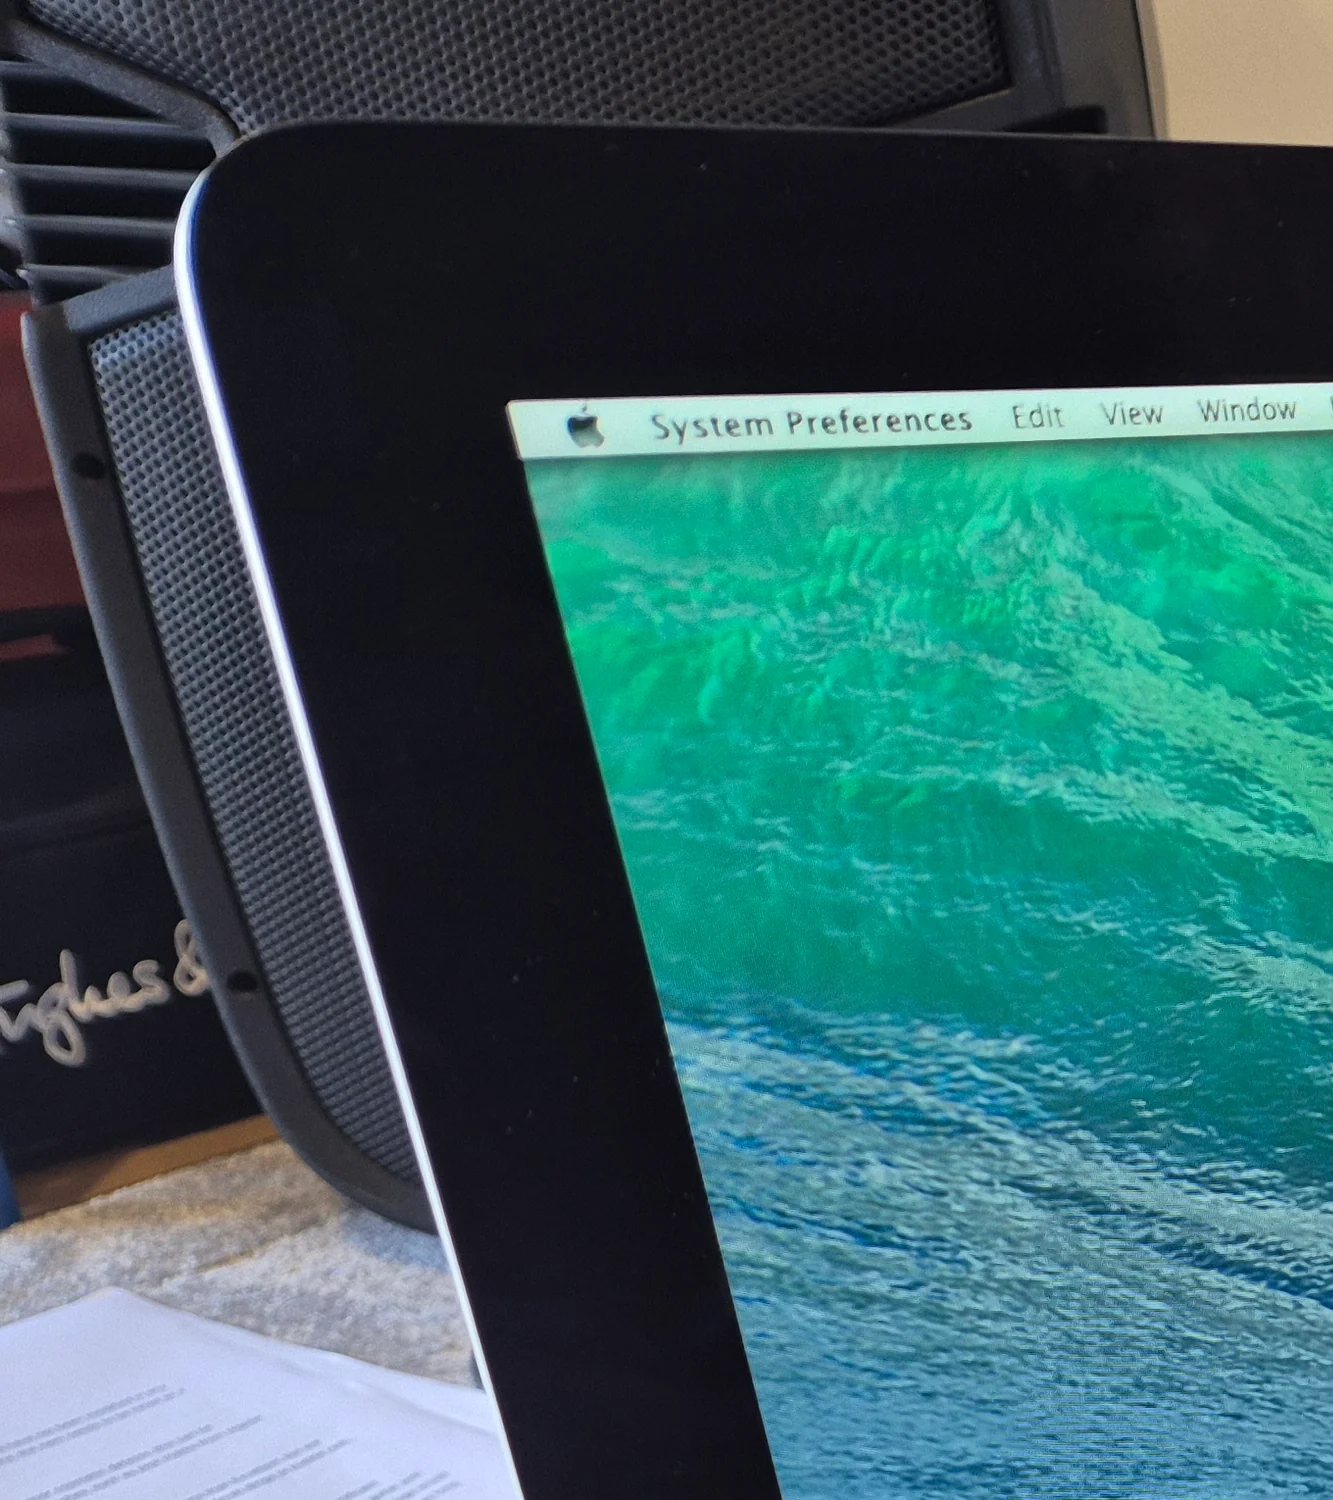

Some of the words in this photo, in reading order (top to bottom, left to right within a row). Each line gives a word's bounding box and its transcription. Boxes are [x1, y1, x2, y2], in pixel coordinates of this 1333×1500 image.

[651, 413, 774, 445] System
[787, 408, 974, 435] Preferences
[1013, 403, 1065, 430] Edit
[1101, 401, 1164, 426] View
[1198, 394, 1298, 423] Window
[0, 949, 170, 1068] ughes
